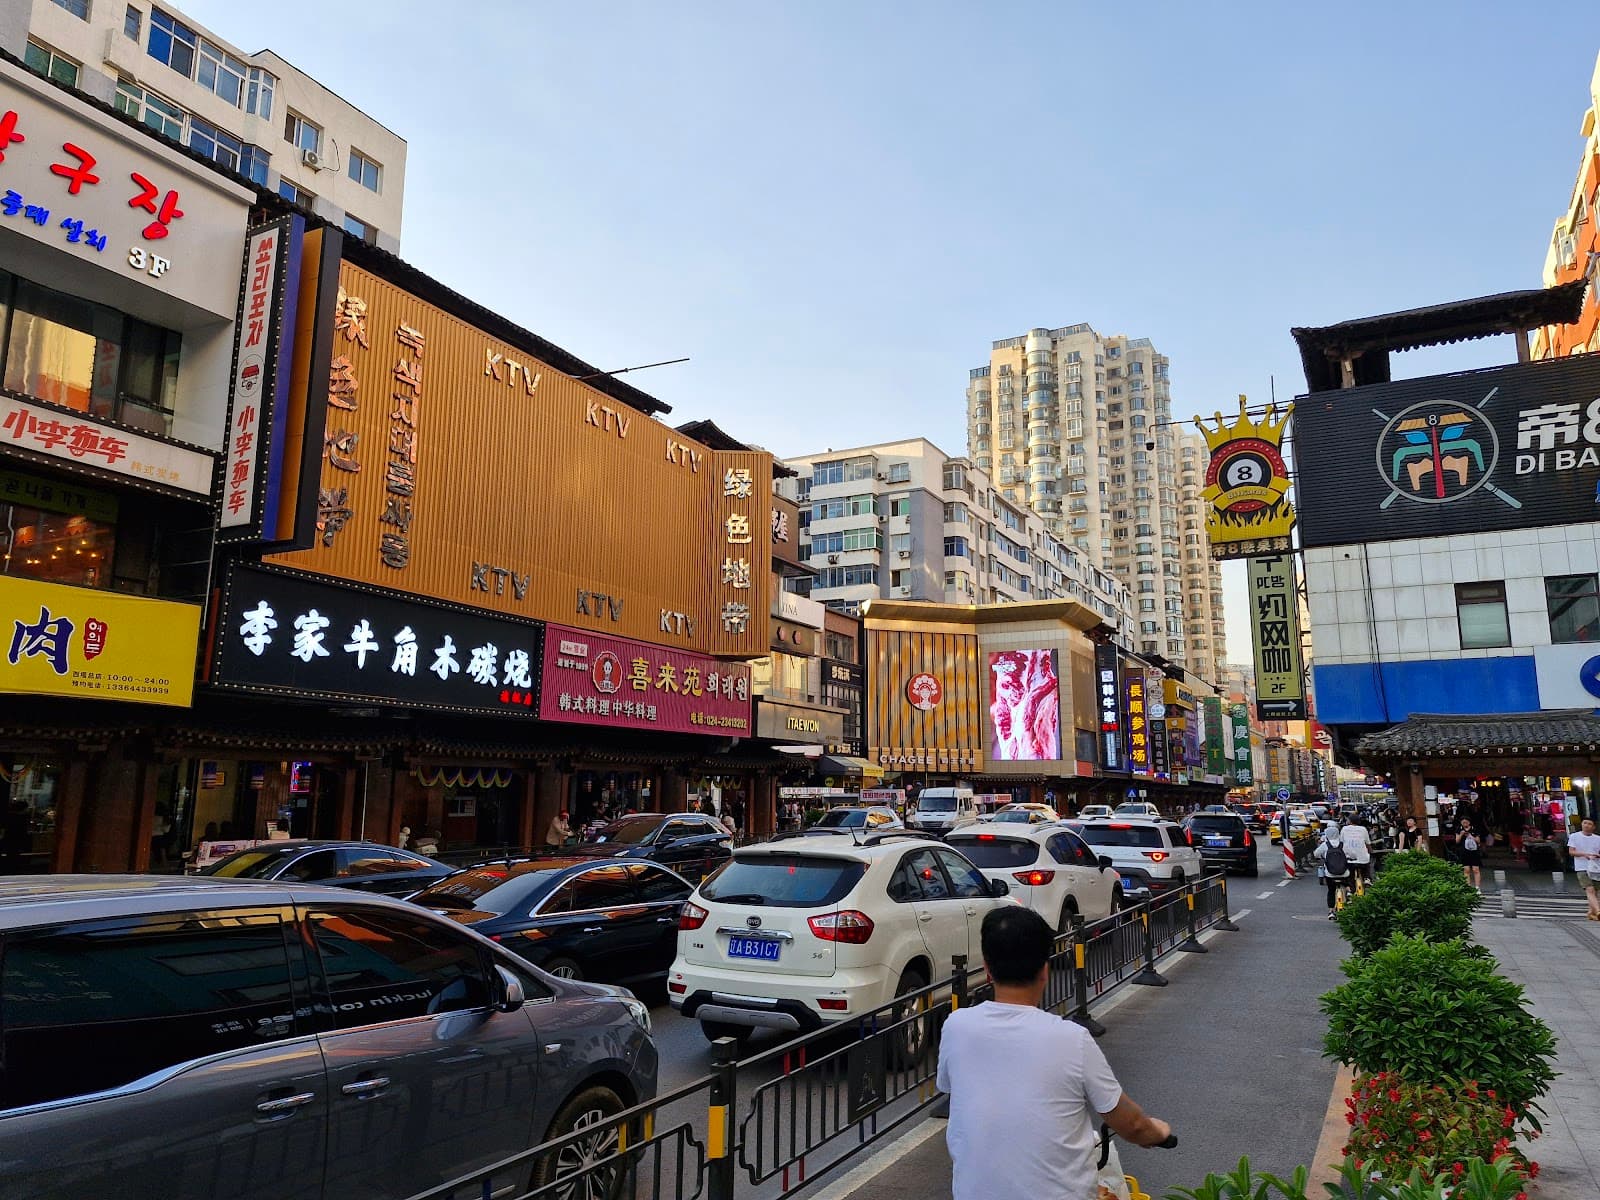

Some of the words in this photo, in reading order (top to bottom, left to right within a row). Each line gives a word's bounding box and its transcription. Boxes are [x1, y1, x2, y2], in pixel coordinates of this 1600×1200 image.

[129, 247, 171, 278] 3F
[245, 236, 274, 348] 쏘리포차
[485, 348, 542, 397] KTV
[585, 398, 631, 439] KTV
[665, 438, 702, 473] KTV
[1237, 466, 1252, 480] 8
[1515, 452, 1545, 475] DI
[722, 468, 752, 634] 绿色地带
[471, 561, 531, 599] KTV
[577, 588, 624, 622] KTV
[8, 605, 75, 676] 肉
[86, 621, 102, 654] 여의도
[660, 608, 697, 639] KTV
[239, 601, 533, 690] 李家牛角木碳烧
[627, 657, 703, 697] 喜来苑
[1271, 683, 1286, 694] 2F
[787, 717, 820, 732] ITAEWON
[879, 755, 934, 765] CHAGEE
[1234, 724, 1252, 783] 慶會樓
